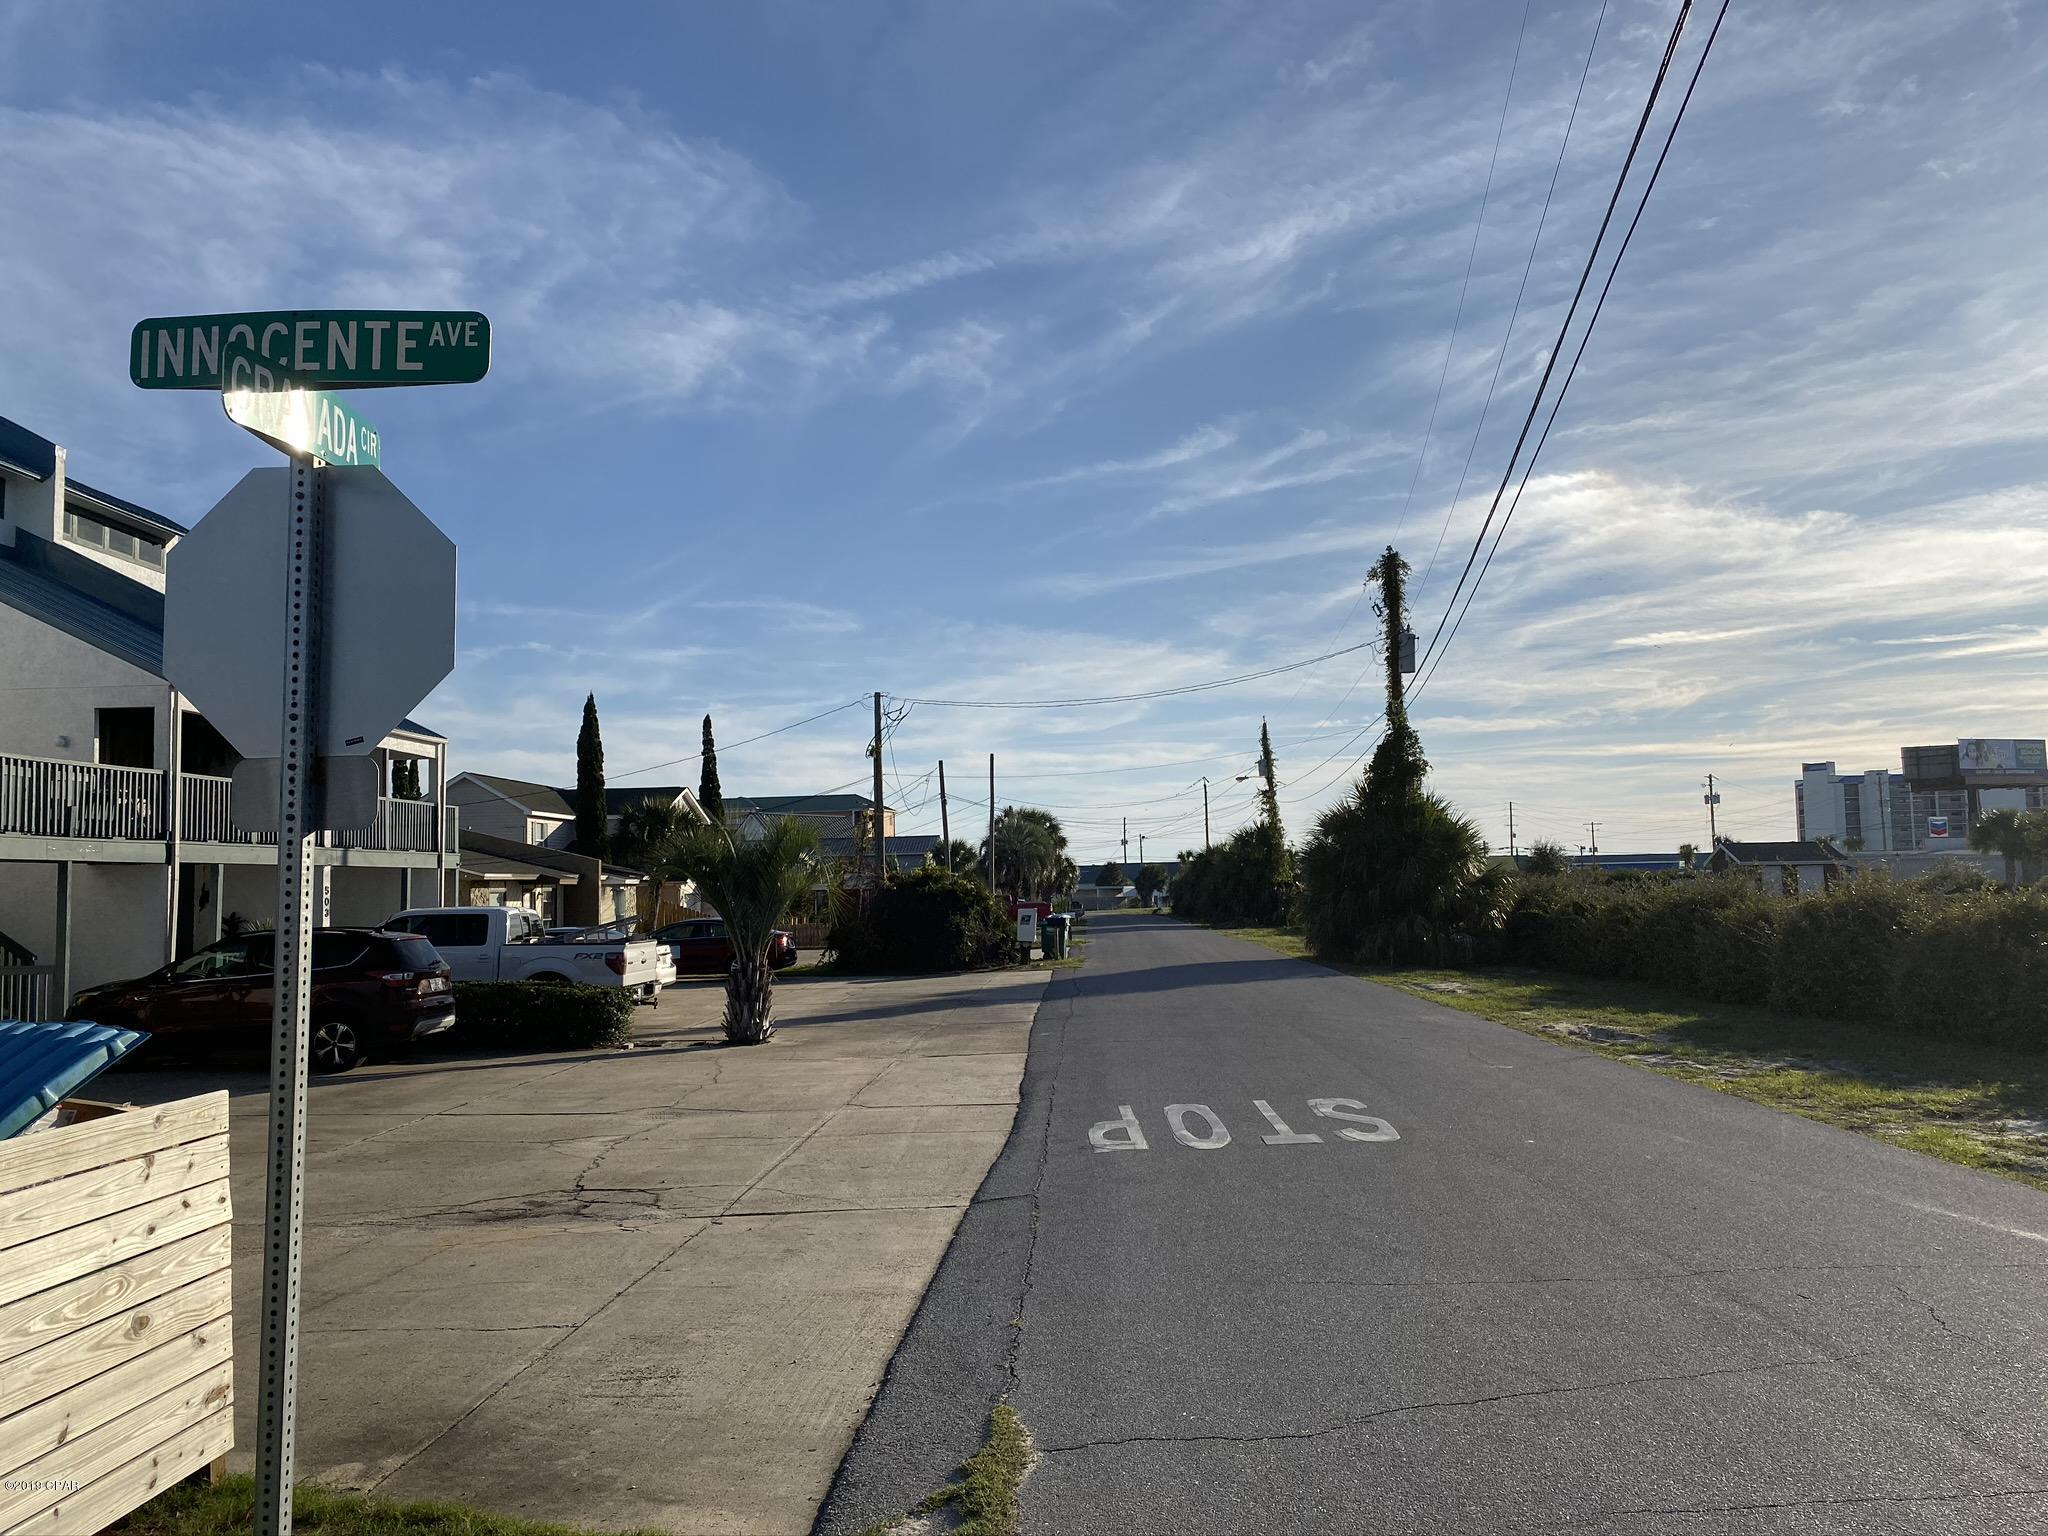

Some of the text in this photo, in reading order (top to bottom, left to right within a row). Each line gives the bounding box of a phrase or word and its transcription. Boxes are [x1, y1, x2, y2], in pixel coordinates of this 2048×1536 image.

[428, 321, 479, 347] AVE
[360, 426, 377, 459] CIR
[1088, 1097, 1401, 1153] STOP
